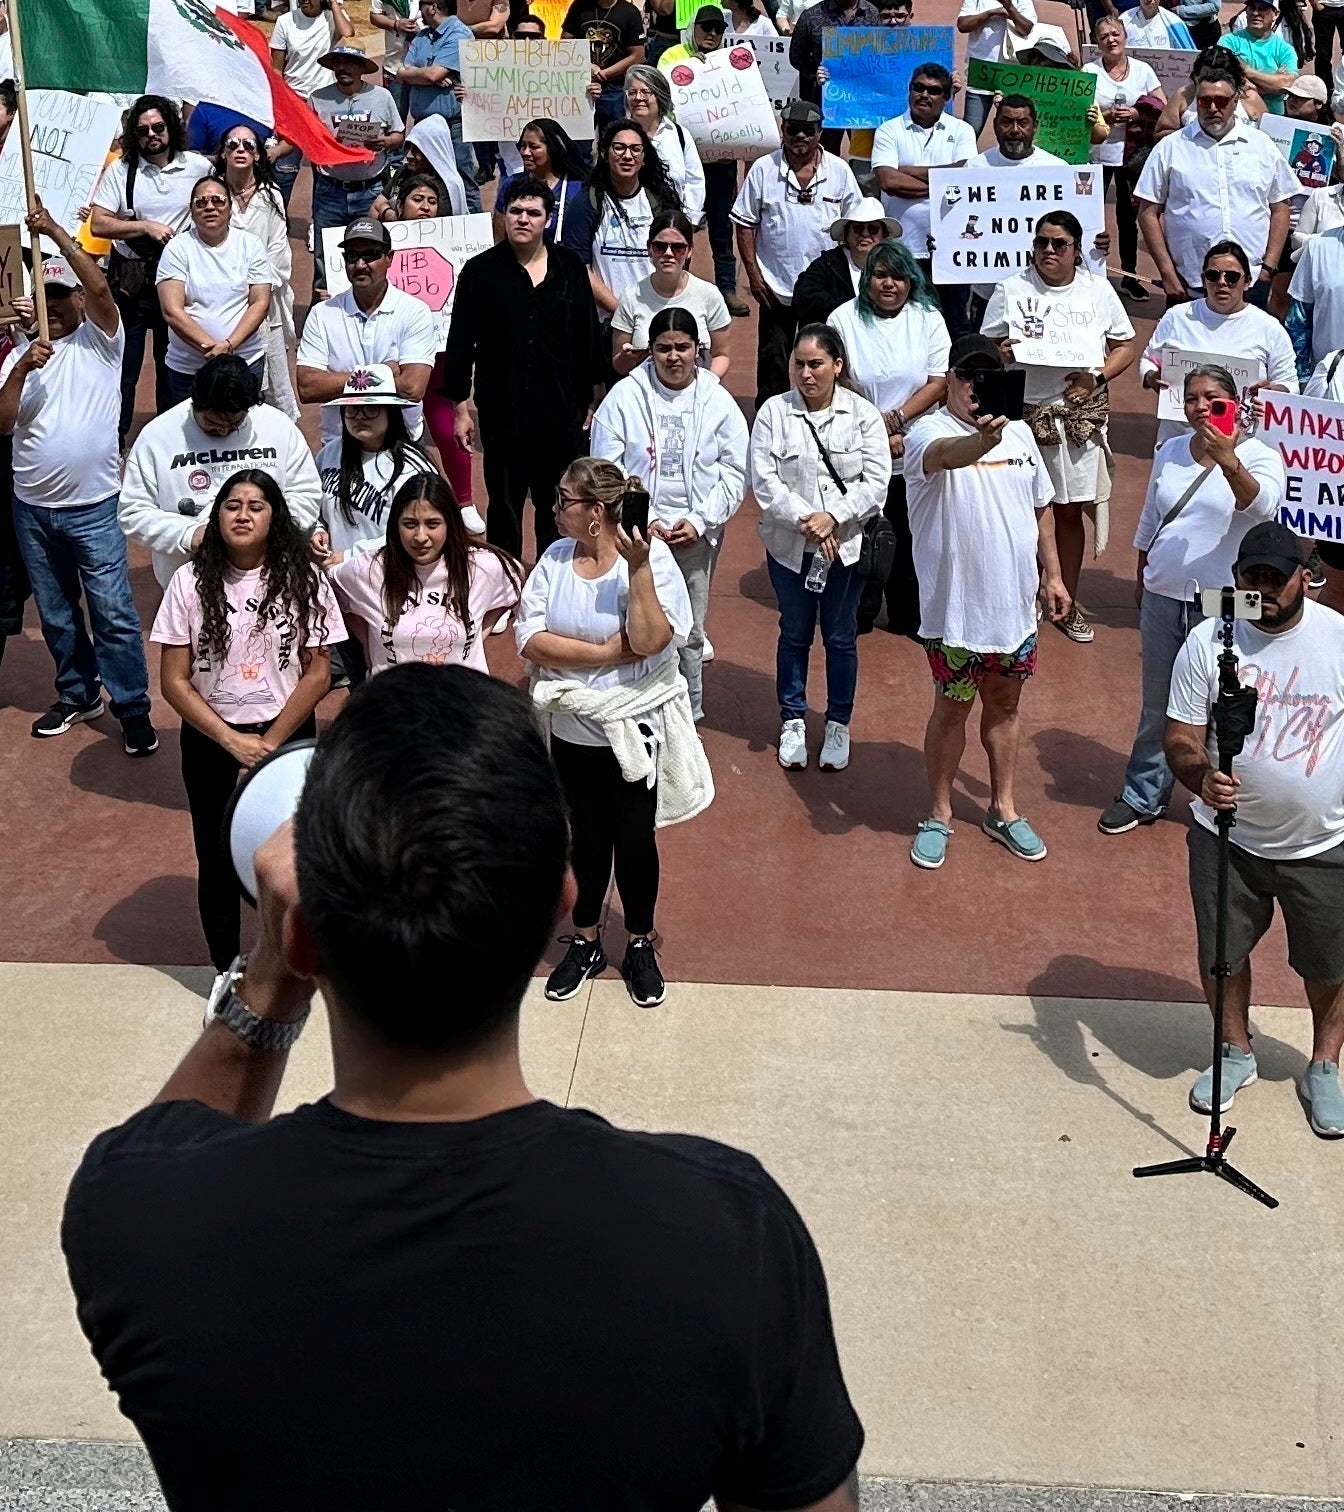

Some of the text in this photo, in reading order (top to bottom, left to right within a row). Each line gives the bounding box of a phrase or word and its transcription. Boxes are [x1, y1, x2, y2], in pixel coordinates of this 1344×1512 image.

[465, 39, 508, 63] STOP
[467, 65, 589, 95] IMMIGRANTS
[978, 64, 1034, 88] STOP
[678, 74, 743, 105] Should
[506, 94, 582, 118] AMERICA
[706, 101, 739, 123] NOT
[346, 123, 375, 133] STOP
[711, 122, 764, 144] Racially
[30, 123, 74, 158] NOT
[967, 184, 1064, 203] WE ARE
[991, 216, 1034, 234] NOT
[401, 251, 429, 273] HB
[1048, 330, 1073, 345] Bill
[170, 446, 278, 471] McLaren
[1285, 475, 1303, 503] E
